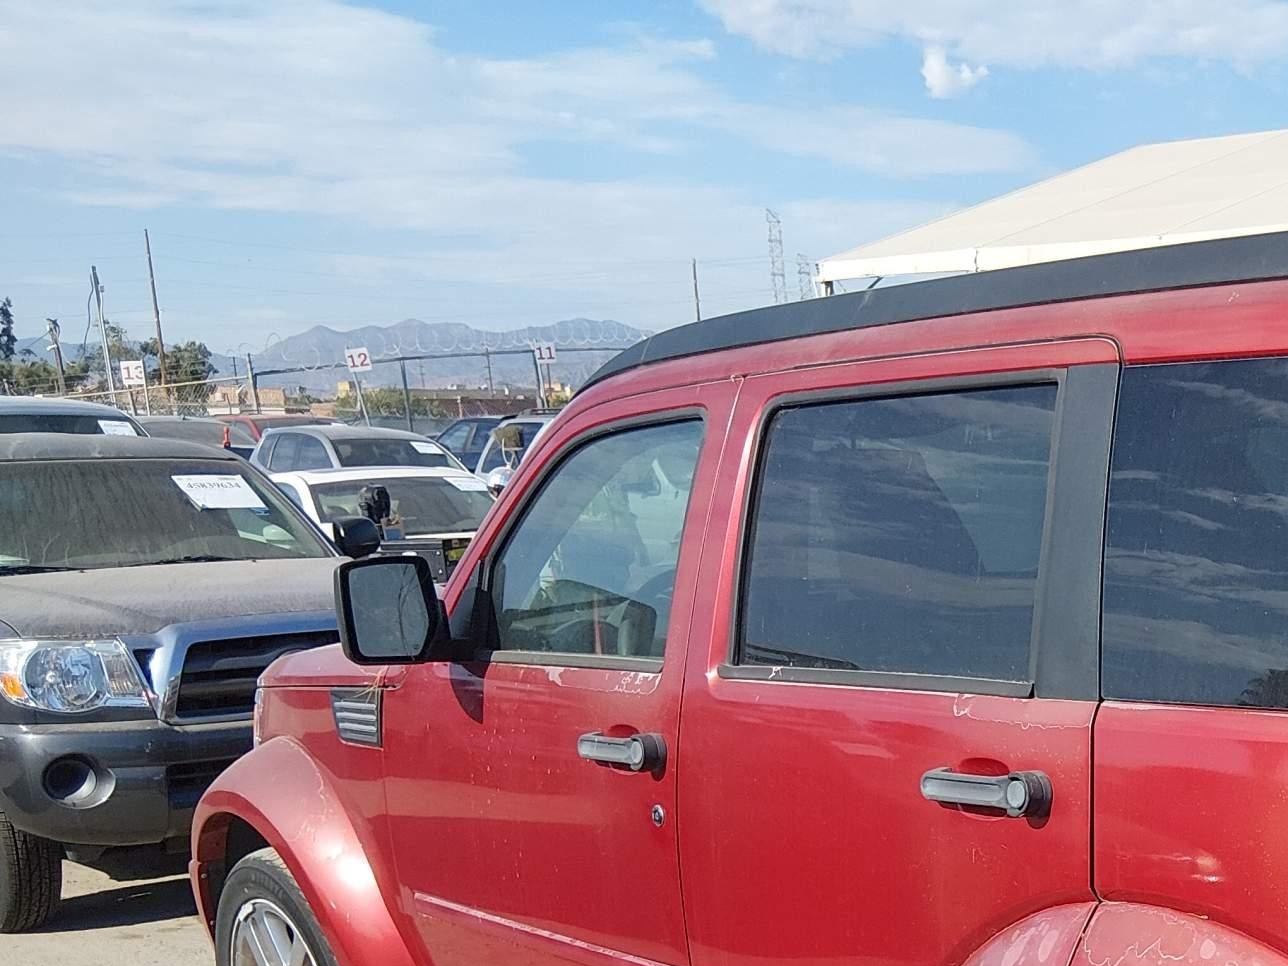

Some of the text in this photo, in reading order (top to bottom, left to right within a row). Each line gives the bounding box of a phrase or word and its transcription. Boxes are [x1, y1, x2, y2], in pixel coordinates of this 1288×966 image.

[536, 346, 555, 360] 11
[347, 353, 370, 368] 12
[122, 366, 143, 380] 13
